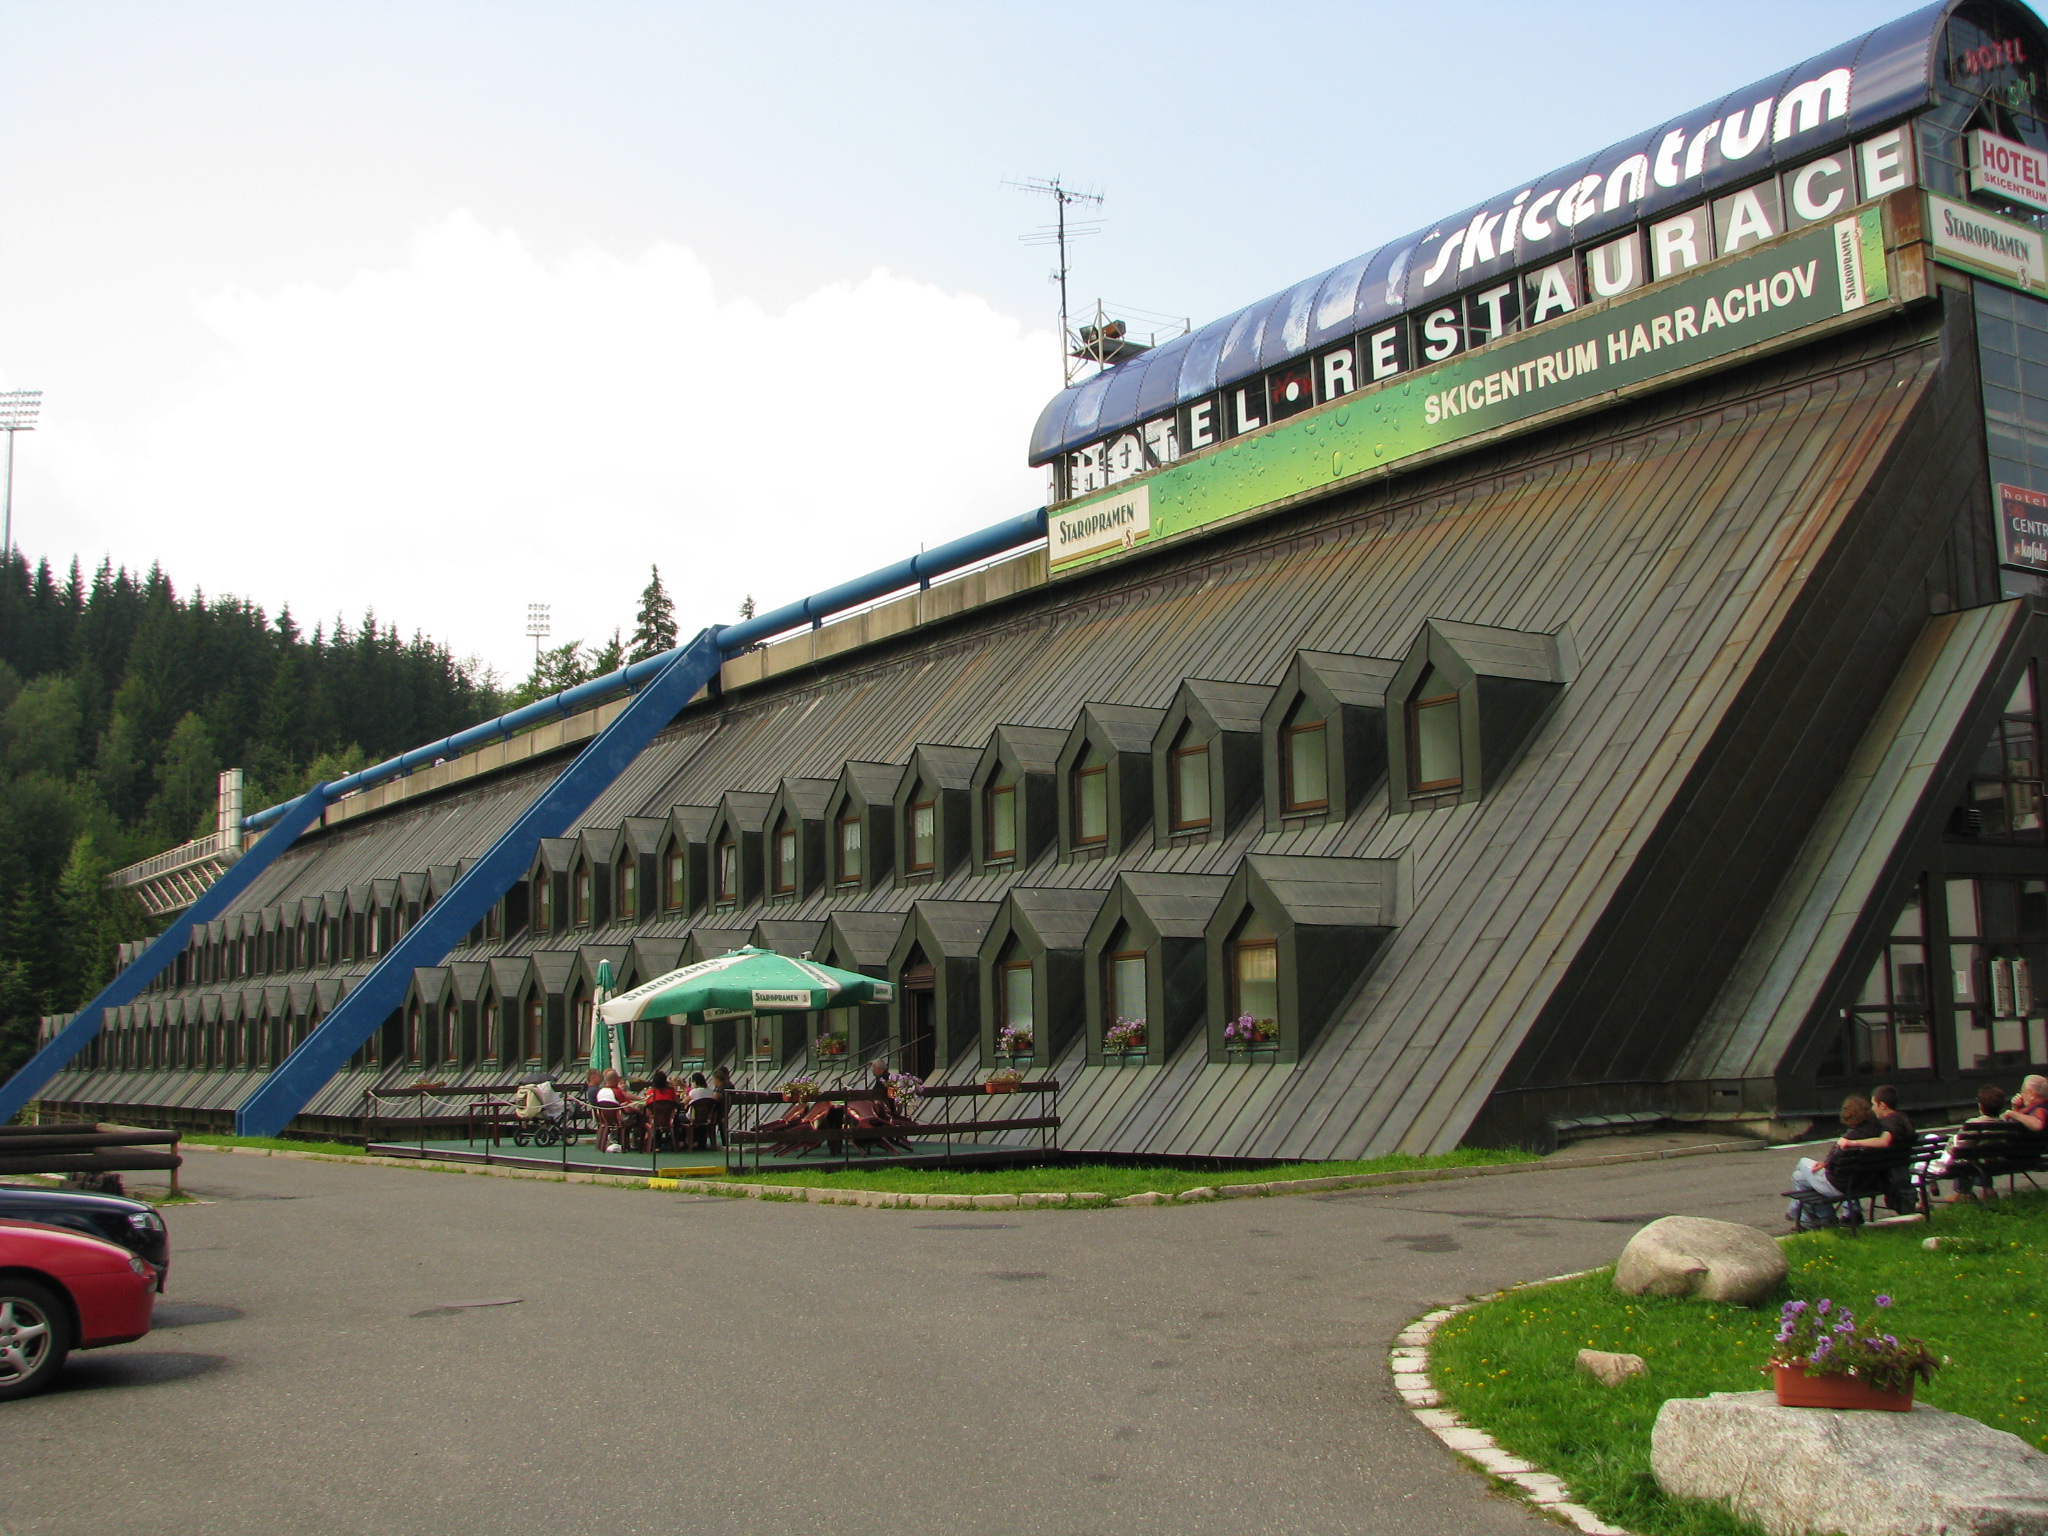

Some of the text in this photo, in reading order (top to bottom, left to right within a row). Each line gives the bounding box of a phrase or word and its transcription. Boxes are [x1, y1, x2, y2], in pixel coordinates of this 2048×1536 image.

[1964, 37, 2027, 76] HOTEL
[1982, 140, 2046, 188] HOTEL
[1984, 172, 2047, 203] SKICENTRUM
[1944, 208, 2030, 263] STAROPRAMEN
[1841, 230, 1856, 301] STAROPRAMEN
[1076, 131, 1905, 494] HOTEL RESTAURACE
[1425, 260, 1818, 425] SKICENTRUM HARRACHOV
[2004, 489, 2047, 507] hotel
[1059, 502, 1134, 544] STAROPRAMEN
[2021, 538, 2047, 563] kofola
[622, 960, 721, 1001] STAROPRAMEN
[755, 992, 799, 1002] STAROPRAMEN
